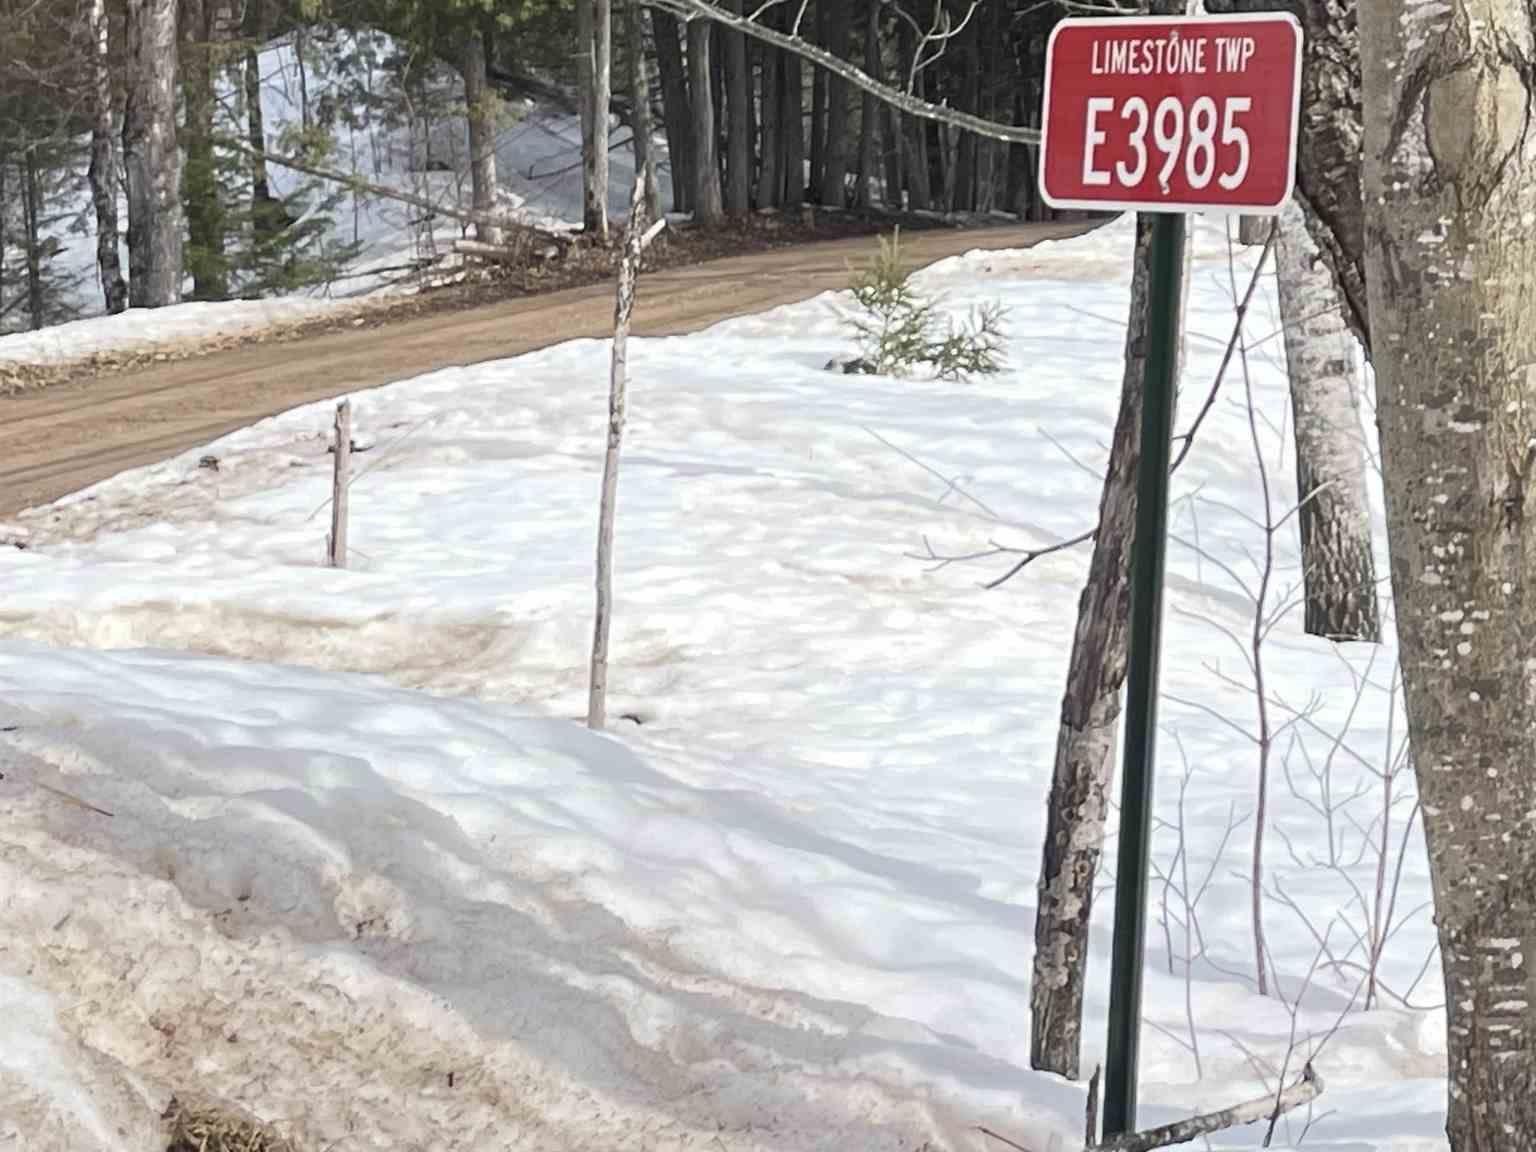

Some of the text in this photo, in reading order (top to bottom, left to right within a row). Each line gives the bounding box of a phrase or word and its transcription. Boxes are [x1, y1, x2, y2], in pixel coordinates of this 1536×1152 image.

[1091, 37, 1256, 75] LIMESTONE TWP
[1082, 96, 1252, 190] E3985
